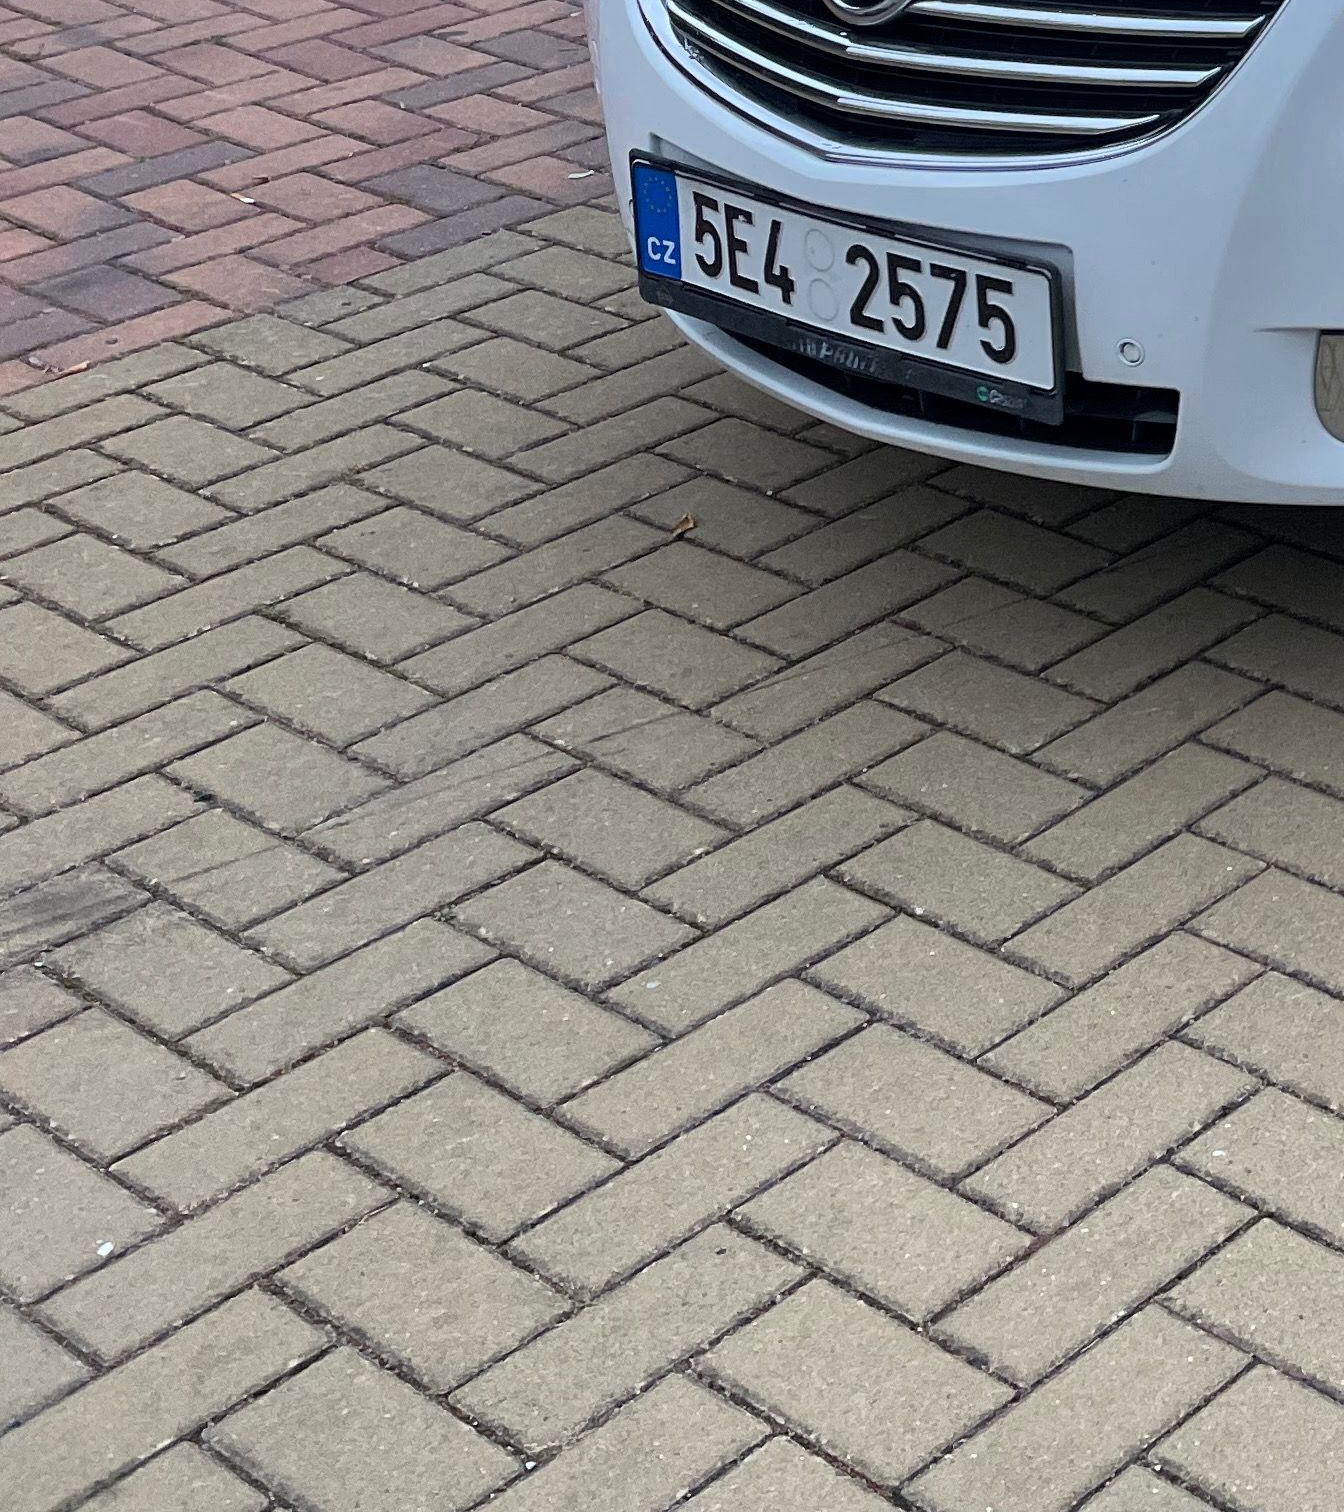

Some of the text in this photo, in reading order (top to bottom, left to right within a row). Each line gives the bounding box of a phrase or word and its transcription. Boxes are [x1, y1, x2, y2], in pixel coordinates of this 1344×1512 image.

[647, 236, 677, 264] CZ
[692, 190, 1017, 364] 5E4 2575
